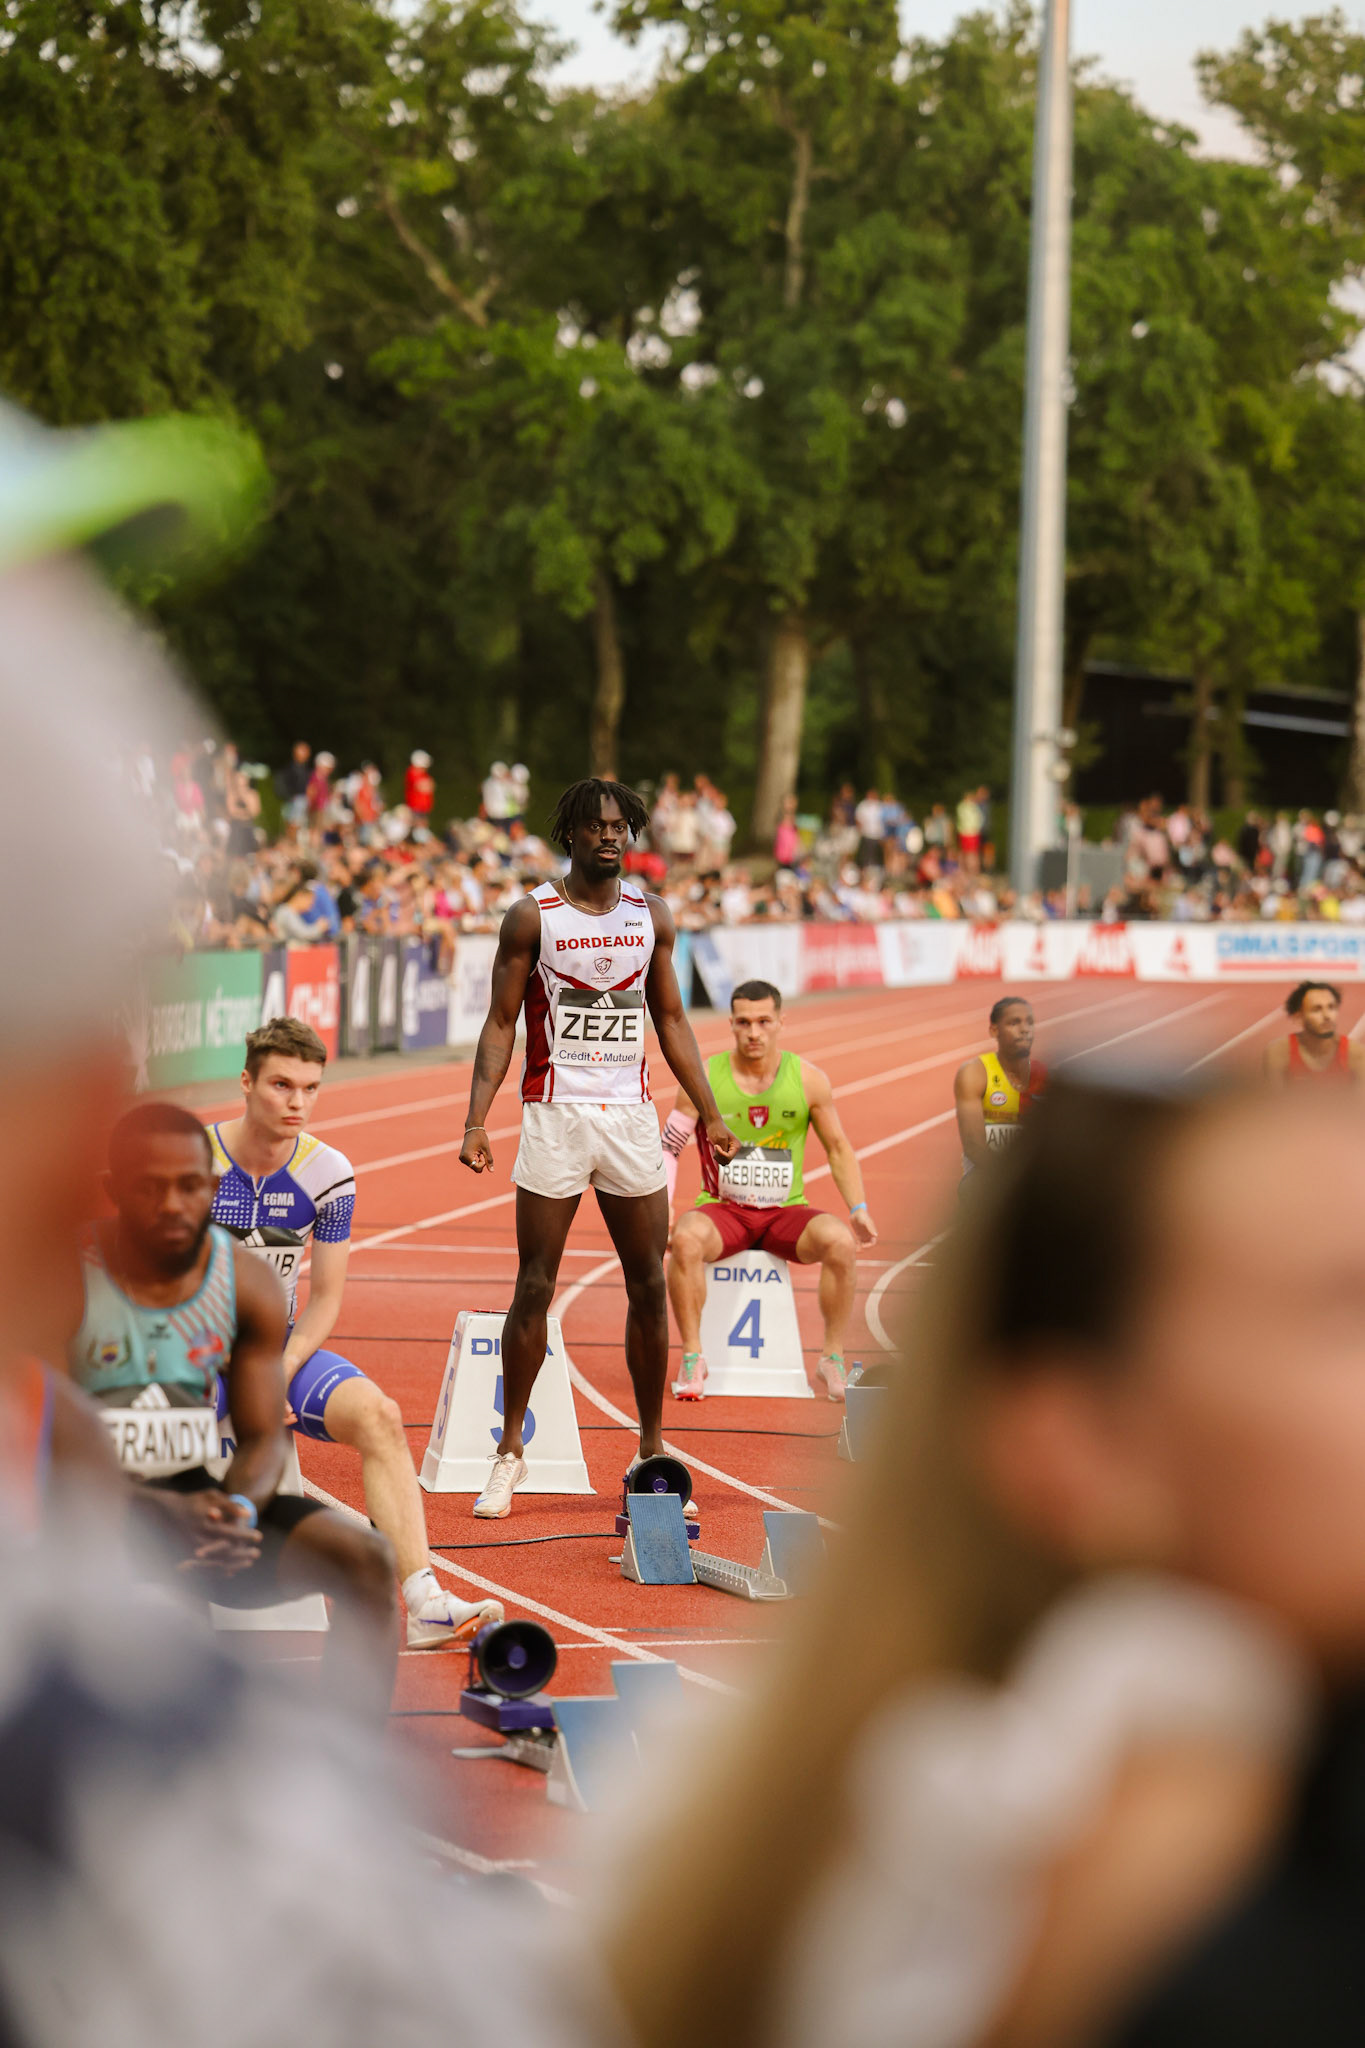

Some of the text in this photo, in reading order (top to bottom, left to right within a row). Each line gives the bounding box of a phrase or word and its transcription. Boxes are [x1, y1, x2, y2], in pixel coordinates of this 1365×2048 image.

[555, 935, 645, 952] BORDEAUX
[560, 1012, 638, 1042] ZEZE
[558, 1049, 636, 1062] Crédit Mutuel
[722, 1165, 789, 1188] REBIERRE
[262, 1192, 295, 1207] EGMA
[713, 1267, 782, 1283] DIMA
[727, 1299, 765, 1359] 4
[471, 1338, 554, 1356] DI
